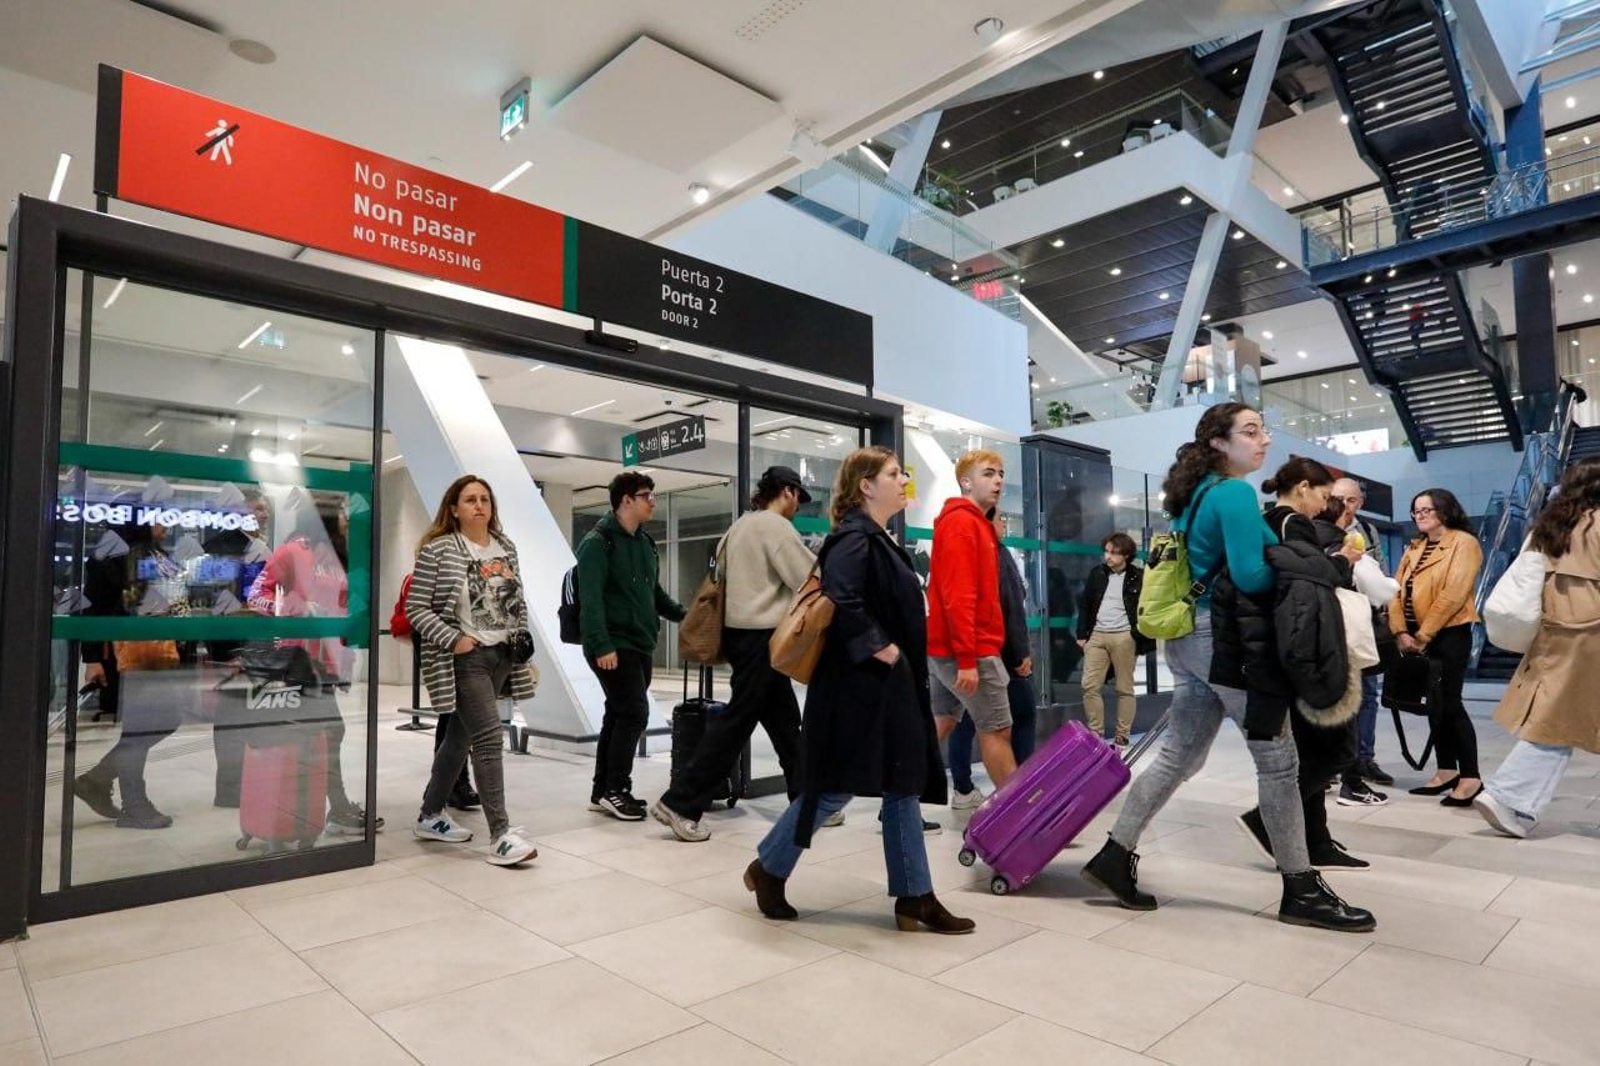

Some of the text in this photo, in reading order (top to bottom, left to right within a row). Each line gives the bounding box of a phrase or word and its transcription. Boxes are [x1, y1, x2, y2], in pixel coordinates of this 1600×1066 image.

[355, 161, 458, 212] No pasar
[354, 193, 477, 246] Non pasar
[353, 225, 482, 271] NO TRESPASSING
[661, 259, 724, 293] Puerta 2
[661, 284, 718, 315] Porta 2
[661, 309, 699, 329] DOOR 2
[681, 423, 705, 443] 2.4
[246, 681, 303, 710] VANS
